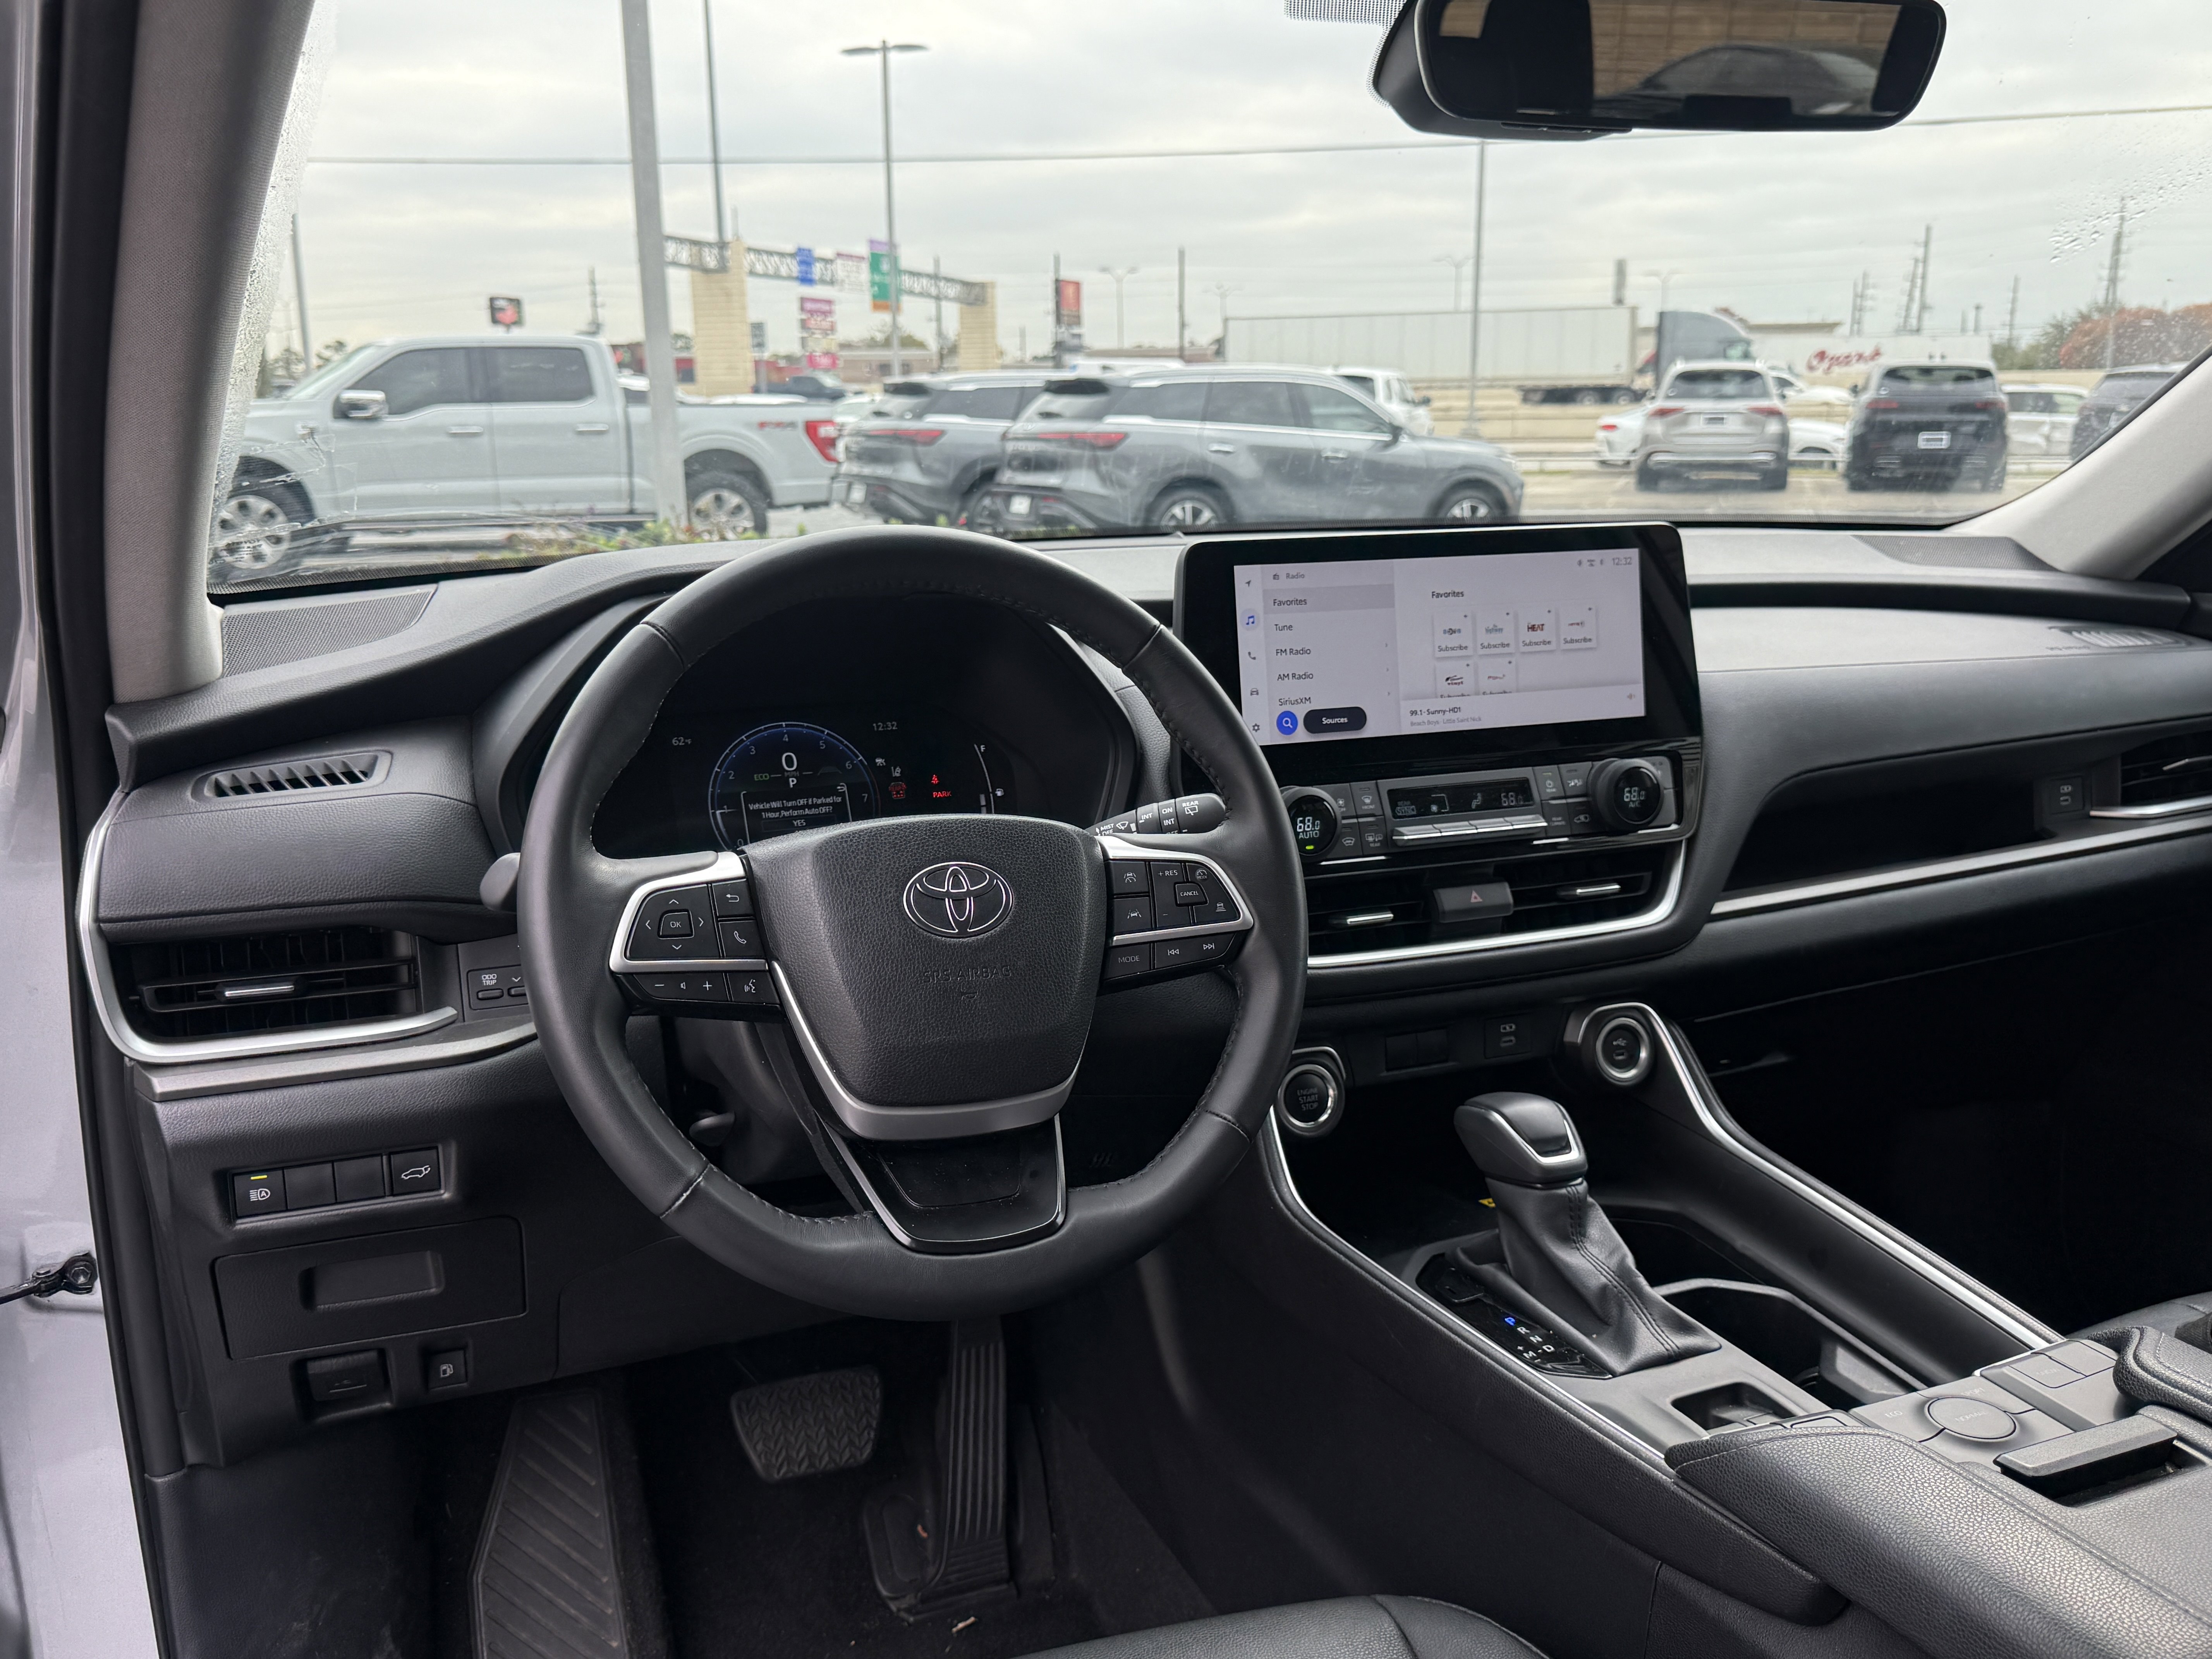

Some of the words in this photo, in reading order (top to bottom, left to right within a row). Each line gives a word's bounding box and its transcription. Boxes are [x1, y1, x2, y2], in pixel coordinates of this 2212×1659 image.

[1612, 557, 1632, 565] 12:32
[1432, 590, 1464, 599] Favorites
[1273, 598, 1307, 606] Favorites
[1527, 623, 1545, 632] HEAT
[1289, 647, 1311, 656] Radio
[1291, 672, 1314, 680] Radio
[1278, 697, 1312, 706] SiriusXM
[873, 721, 898, 731] 12:32
[782, 734, 788, 742] 4
[819, 741, 826, 749] 5
[750, 746, 756, 755] 3
[781, 752, 797, 771] 0
[846, 761, 852, 769] 6
[729, 771, 735, 780] 2
[789, 778, 797, 788] P
[862, 794, 868, 802] 7
[748, 802, 770, 811] Vehicle
[813, 796, 833, 804] Parked
[1297, 816, 1320, 832] 68.0
[1298, 831, 1320, 840] AUTO
[737, 839, 744, 847] 0
[1118, 955, 1140, 963] MODE
[922, 969, 952, 984] SRS
[957, 966, 1012, 982] AIRBAG
[1298, 1094, 1319, 1104] START
[1301, 1102, 1319, 1111] STOP
[1505, 1317, 1516, 1326] P
[1516, 1326, 1530, 1334] R
[1529, 1335, 1543, 1343] N
[1542, 1345, 1555, 1353] D
[1522, 1351, 1537, 1359] M
[1884, 1410, 1903, 1419] ECO
[1954, 1411, 1989, 1422] NORMAL
